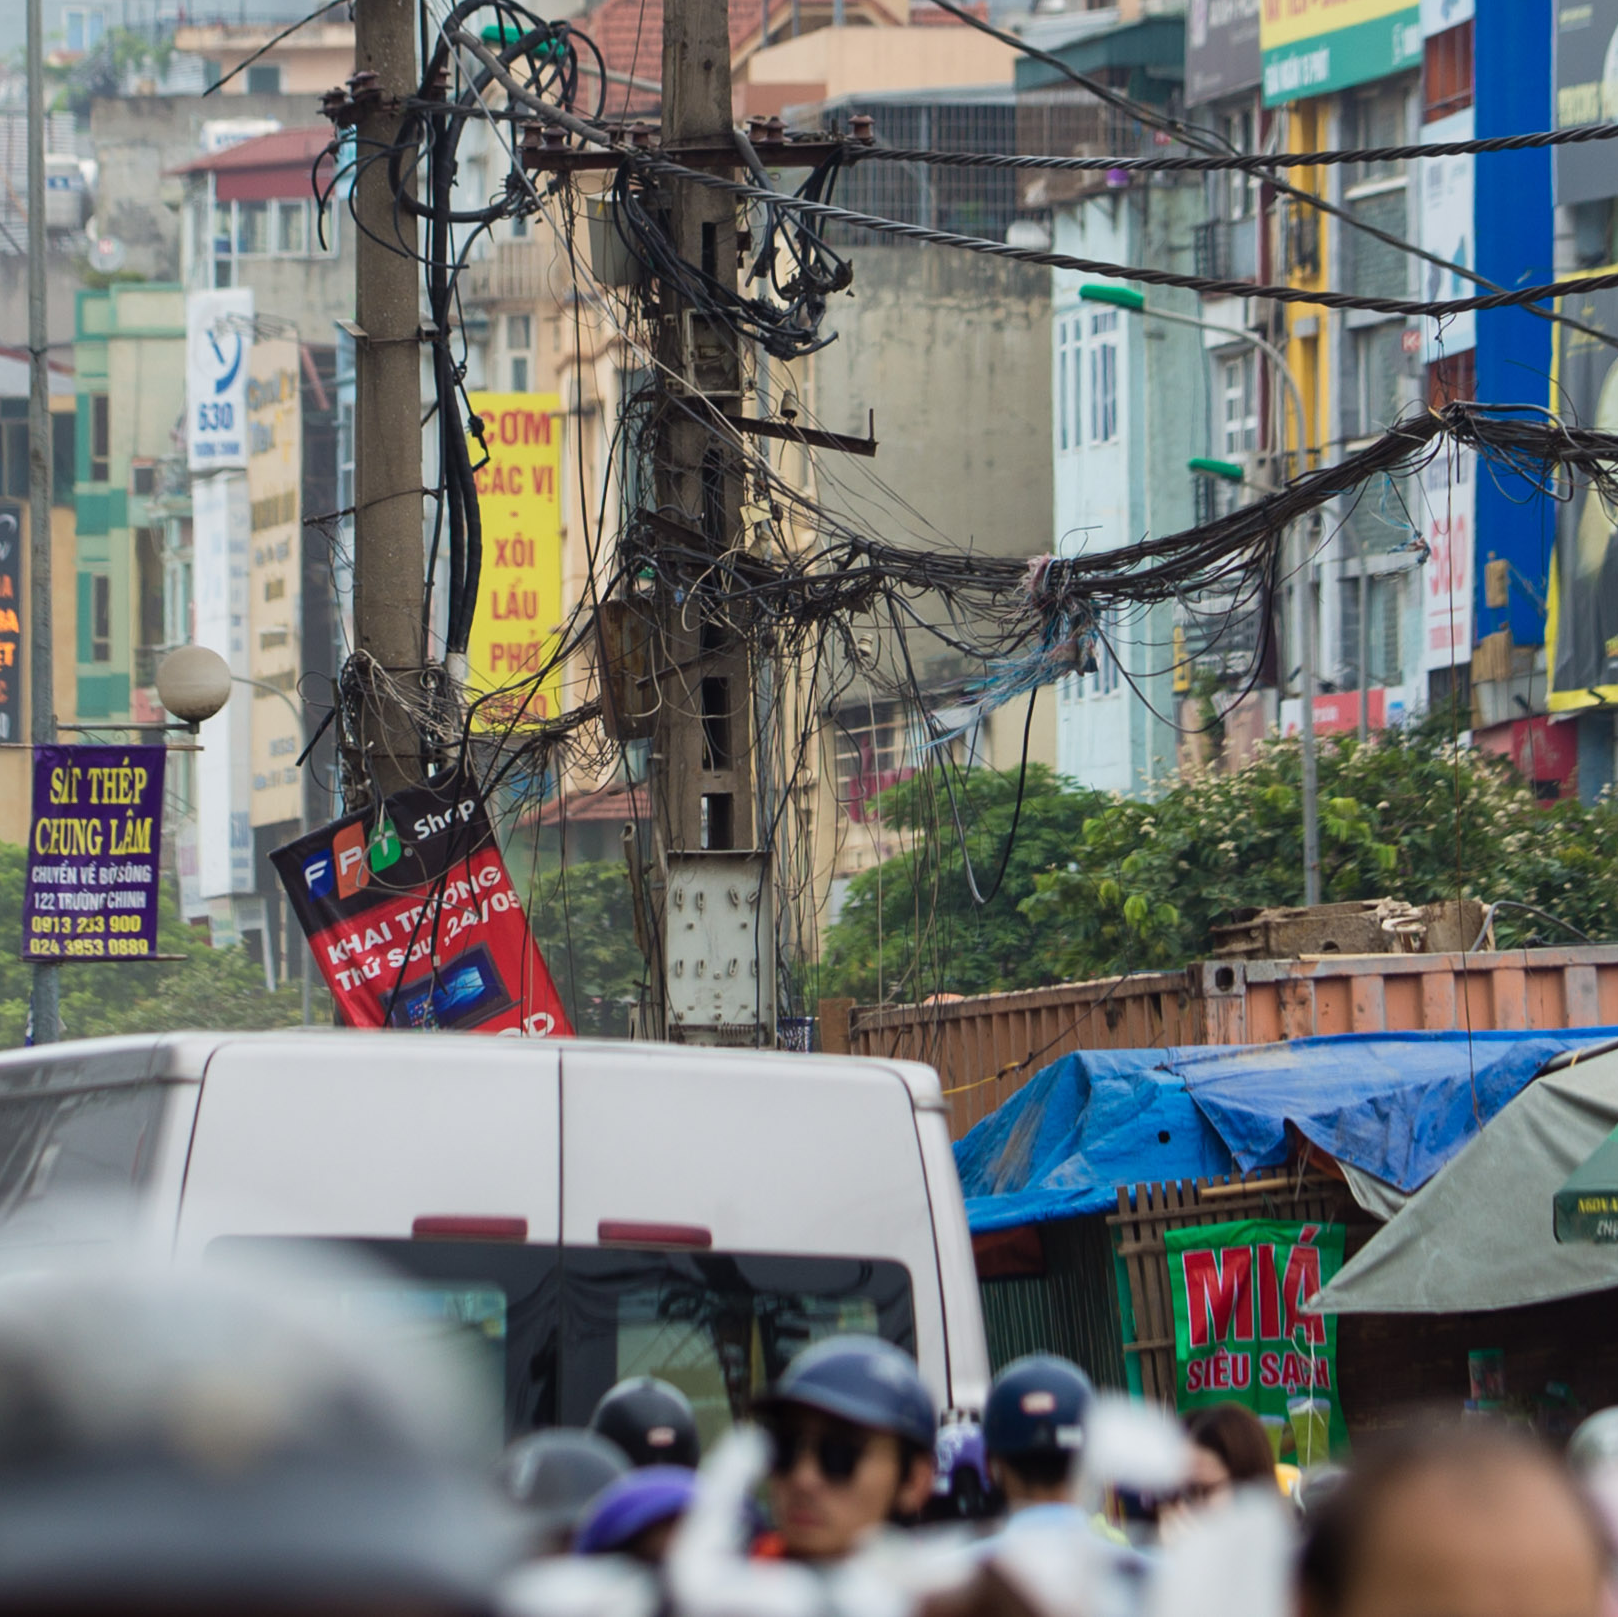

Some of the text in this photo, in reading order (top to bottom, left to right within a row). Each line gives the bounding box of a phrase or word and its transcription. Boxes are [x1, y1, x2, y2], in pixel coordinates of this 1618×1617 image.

[199, 402, 234, 431] 630
[479, 408, 552, 446] CƠM
[532, 465, 555, 503] VỊ
[494, 532, 536, 569] XÔI
[87, 756, 148, 805] THÉP
[109, 808, 153, 856] LÂM
[304, 828, 396, 890] FPT
[34, 892, 55, 910] 122
[32, 915, 71, 932] 0913
[109, 915, 141, 932] 900
[30, 938, 60, 955] 024
[328, 921, 394, 965] KHAI
[335, 955, 381, 991] Thứ
[1186, 1345, 1331, 1396] SIÊU SẠCH
